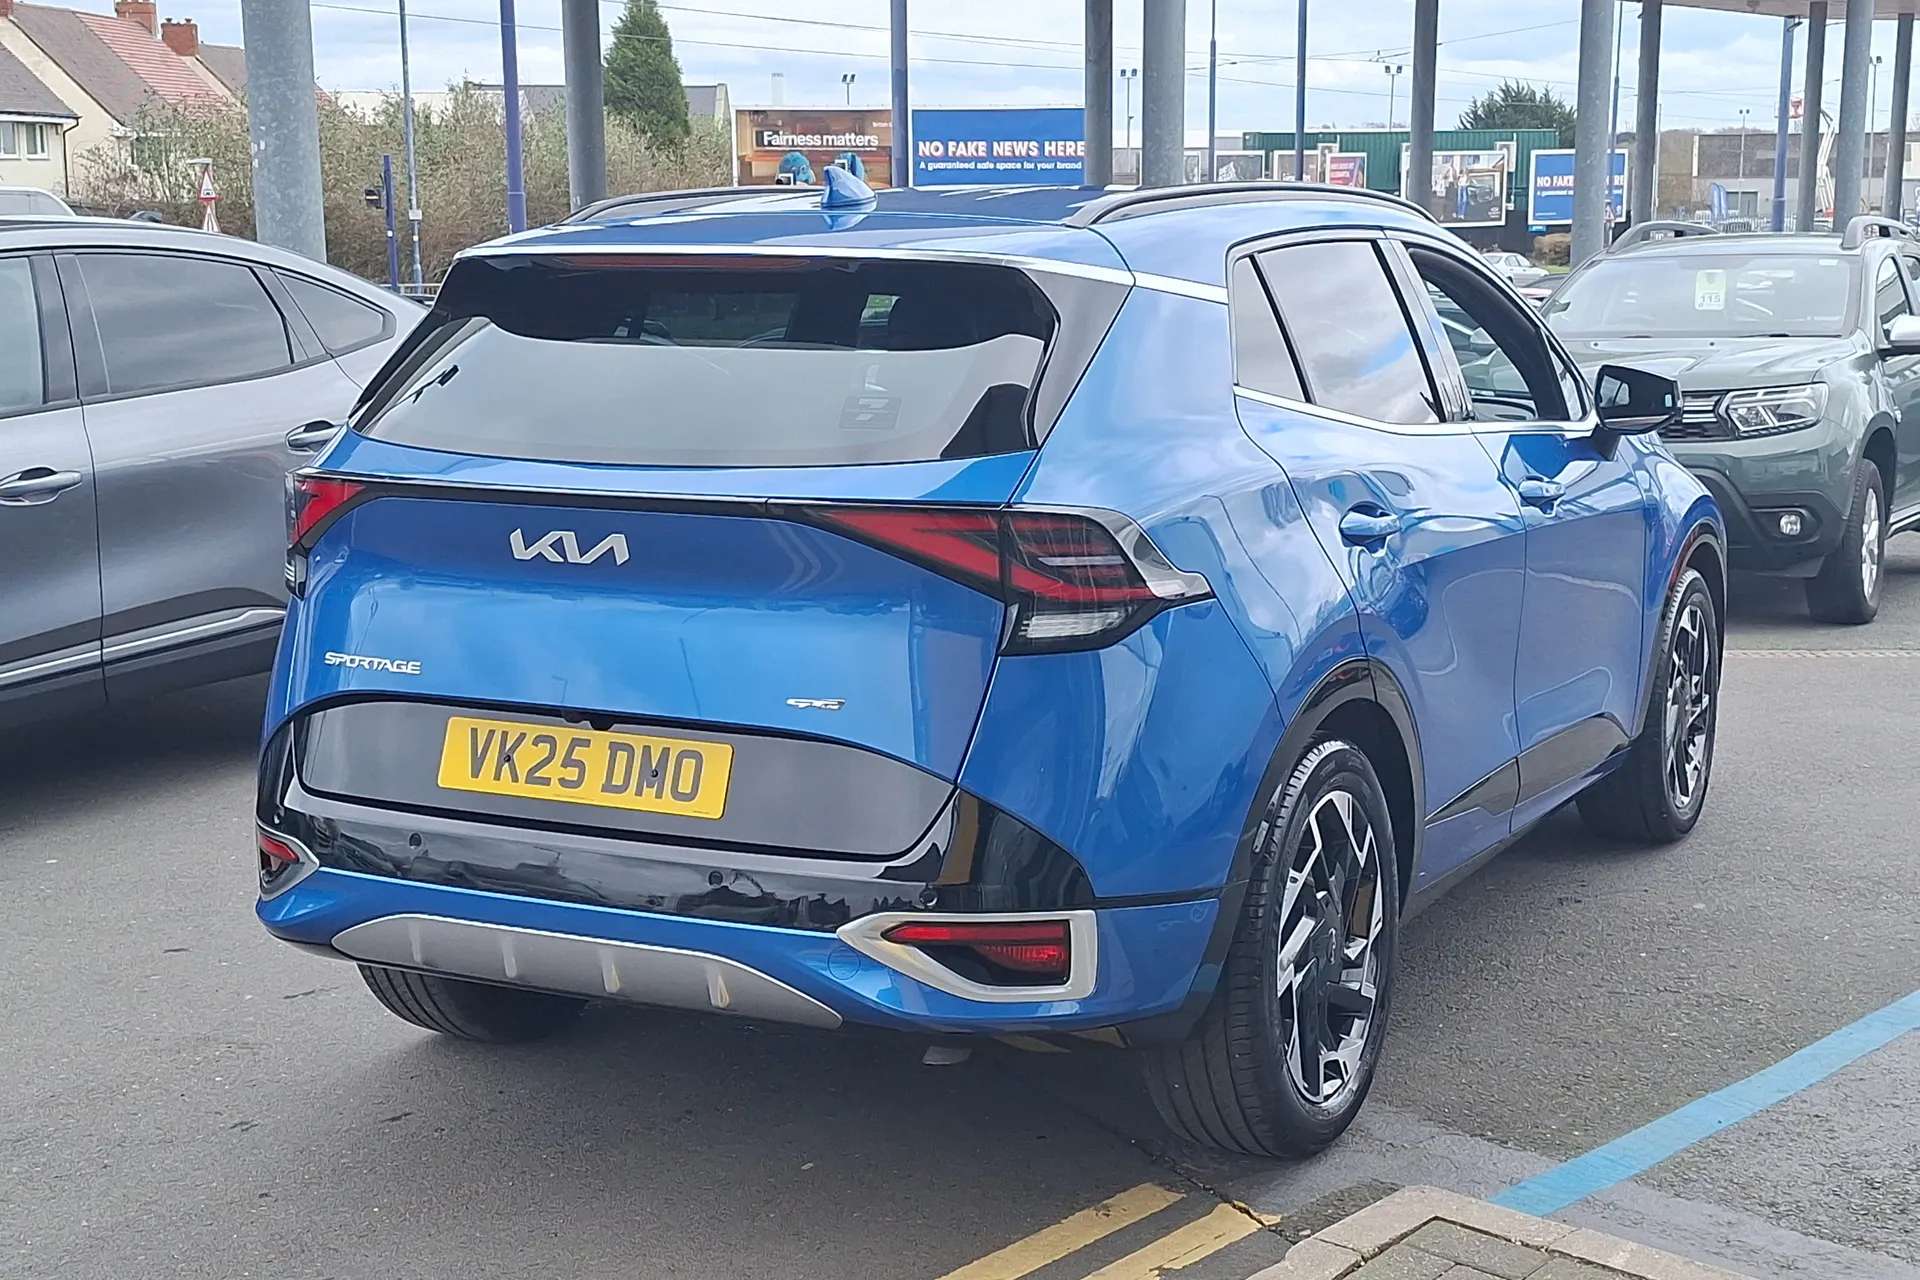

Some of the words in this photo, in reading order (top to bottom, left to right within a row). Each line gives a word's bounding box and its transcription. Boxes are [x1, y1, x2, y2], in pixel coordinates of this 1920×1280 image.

[763, 131, 821, 146] Fairness
[823, 132, 879, 146] matters
[918, 141, 944, 157] NO
[948, 141, 987, 157] FAKE
[993, 141, 1039, 157] NEWS
[1044, 141, 1085, 157] HERE
[919, 161, 926, 169] A
[927, 161, 975, 171] guaranteed
[976, 161, 994, 169] safe
[996, 162, 1022, 171] space
[1023, 161, 1035, 169] for
[1036, 162, 1055, 171] your
[1056, 161, 1082, 169] brand
[1537, 176, 1551, 187] NO
[1552, 175, 1575, 187] FAKE
[510, 528, 630, 566] KIA
[324, 651, 422, 675] SPORTAGE
[469, 727, 591, 790] VK25
[601, 742, 704, 803] DMO
